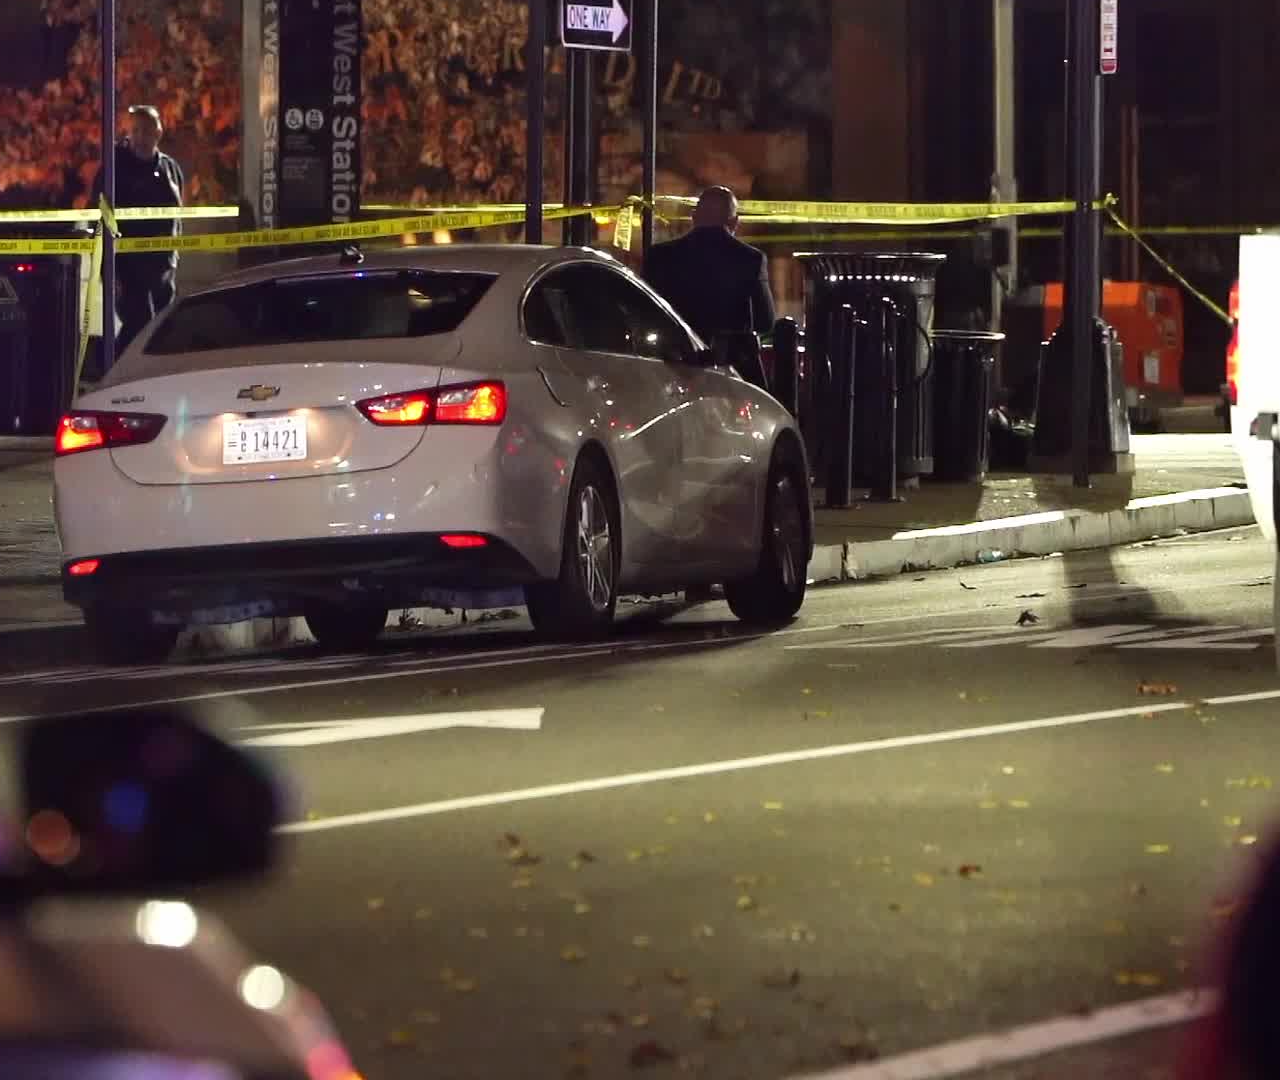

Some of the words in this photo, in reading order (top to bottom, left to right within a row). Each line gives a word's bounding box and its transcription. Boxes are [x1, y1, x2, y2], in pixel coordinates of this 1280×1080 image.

[569, 6, 589, 28] ONE
[592, 8, 612, 30] WAY
[332, 24, 357, 104] West
[254, 429, 299, 452] 14421
